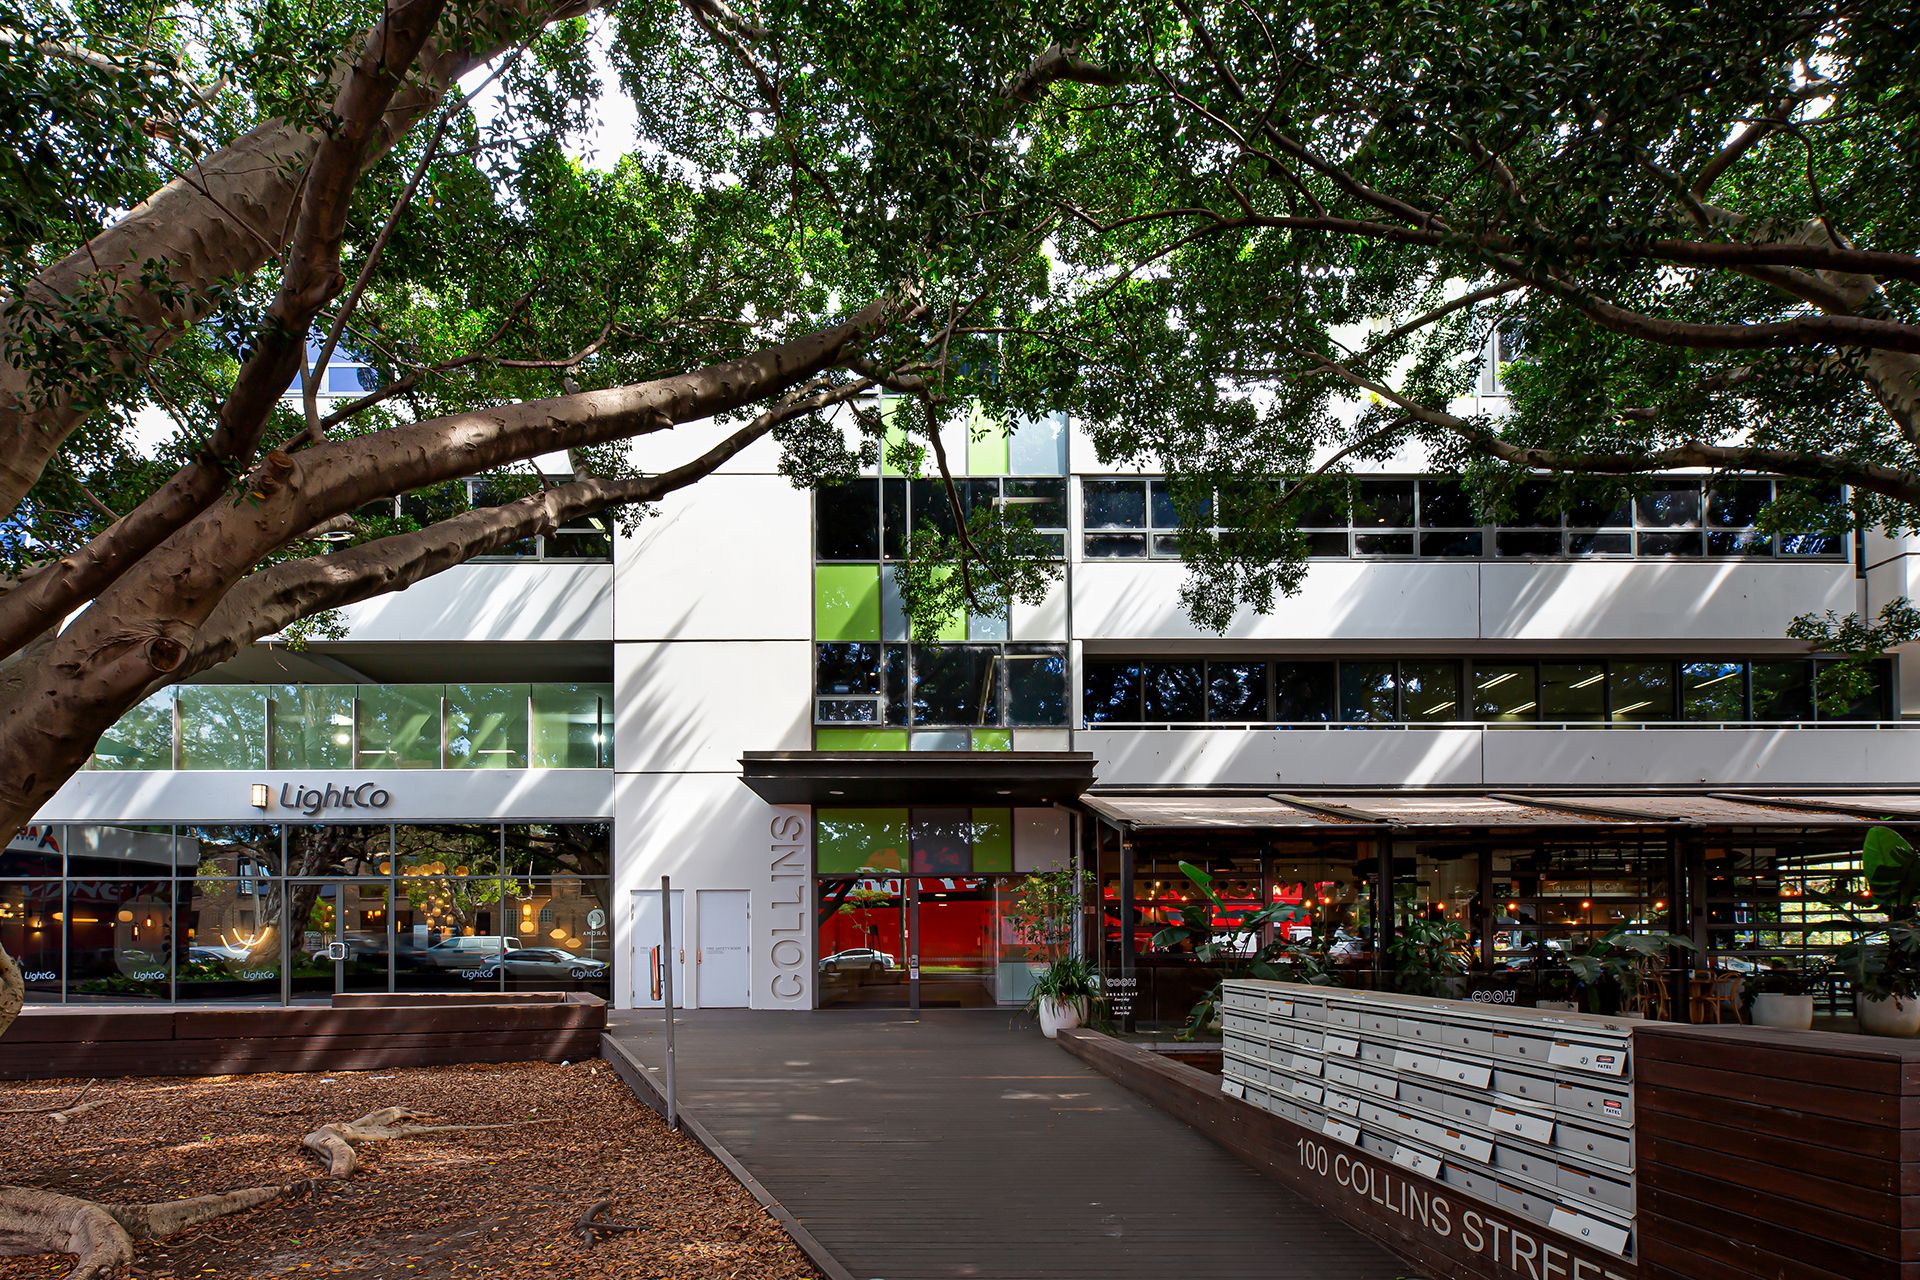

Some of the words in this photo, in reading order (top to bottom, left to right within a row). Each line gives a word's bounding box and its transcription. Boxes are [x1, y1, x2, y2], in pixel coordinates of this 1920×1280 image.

[280, 782, 390, 816] LightCo
[770, 815, 806, 1003] COLLINS
[24, 971, 56, 982] LightCo
[133, 971, 165, 982] LightCo
[243, 970, 275, 981] LightCo
[462, 970, 494, 981] LightCo
[571, 969, 603, 980] LightCo
[1106, 977, 1137, 987] COOH
[1471, 990, 1516, 1003] COOH
[1296, 1137, 1329, 1177] 100
[1334, 1153, 1452, 1237] COLLINS
[1461, 1210, 1629, 1280] STRE
